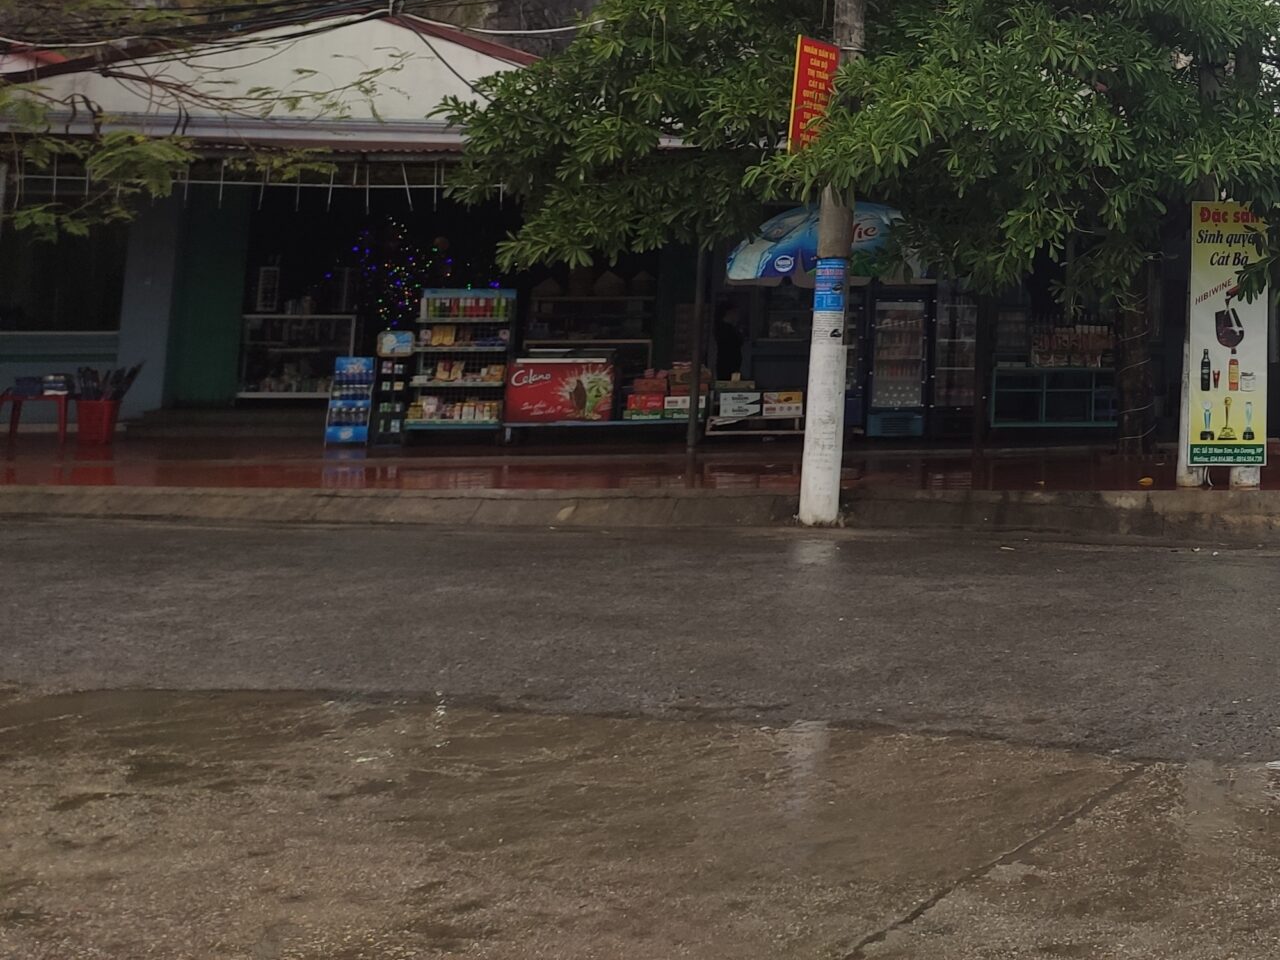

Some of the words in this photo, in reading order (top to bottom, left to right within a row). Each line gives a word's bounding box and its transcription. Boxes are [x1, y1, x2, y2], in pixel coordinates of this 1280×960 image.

[1200, 206, 1228, 227] Đặc
[1196, 229, 1223, 244] Sinh
[1226, 232, 1256, 247] quy
[1210, 251, 1231, 266] Cát
[1195, 277, 1233, 305] HIBIWINE
